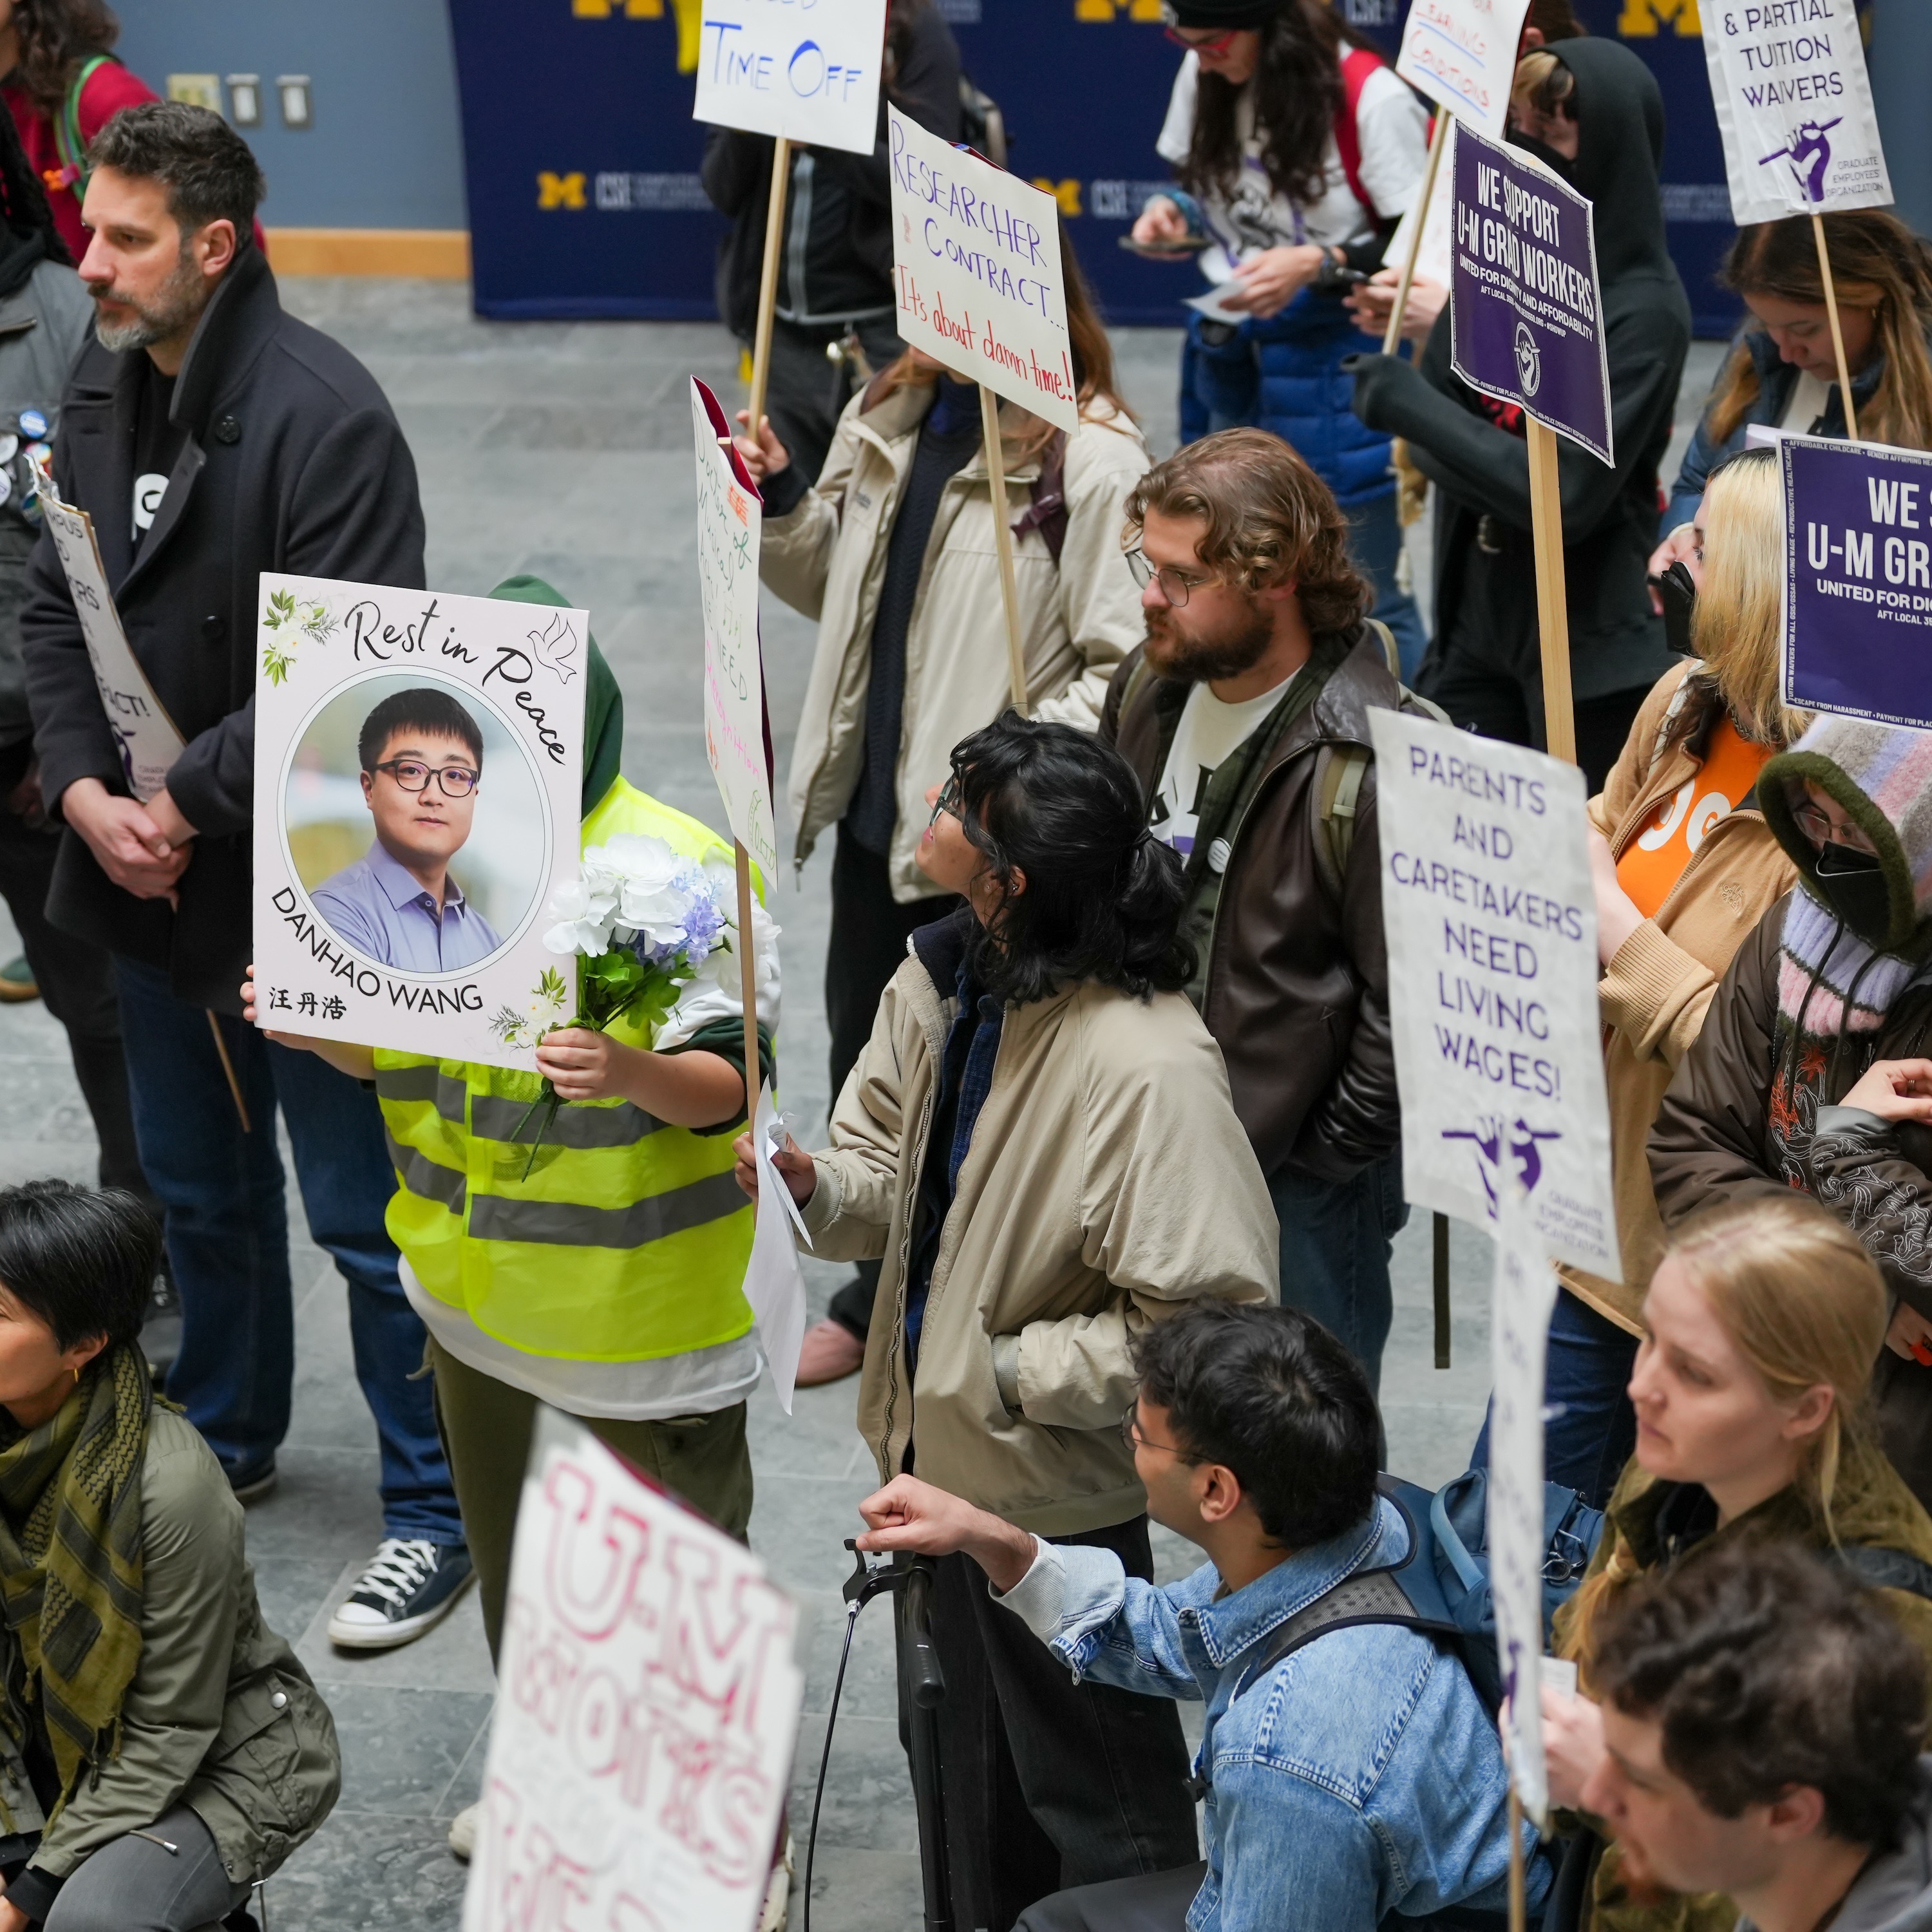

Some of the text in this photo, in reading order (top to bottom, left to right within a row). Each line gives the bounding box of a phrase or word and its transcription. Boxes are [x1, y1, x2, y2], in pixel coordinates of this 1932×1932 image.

[1724, 0, 1834, 35] & PARTIAL
[705, 20, 862, 102] TIME OFF
[1408, 30, 1490, 107] CONDITIONS
[1740, 33, 1833, 71] TUITION
[1741, 71, 1844, 108] WAIVERS
[537, 171, 586, 211] M
[1825, 182, 1885, 198] ORGANIZATION
[1837, 156, 1879, 170] GRADUATE
[891, 119, 1048, 267] RESEARCHER
[1477, 161, 1501, 212] WE
[1503, 175, 1559, 248] SUPPORT
[1458, 200, 1479, 256] U-M
[1483, 218, 1520, 279] GRAD
[1522, 241, 1595, 322] WORKERS
[1459, 252, 1479, 278] UNITED
[1480, 267, 1500, 285] FOR
[1501, 274, 1522, 302] DIGNITY
[1522, 291, 1537, 310] AND
[1538, 300, 1593, 342] AFFORDABILITY
[1481, 285, 1492, 296] AFT
[1491, 289, 1506, 301] LOCAL
[1546, 321, 1567, 338] #SHOWUP
[896, 264, 1074, 402] It's about damn time!
[1481, 381, 1497, 392] PAYMENT
[1785, 447, 1794, 487] HEALTHCARE
[1789, 439, 1862, 455] AFFORDABLE CHILDCARE
[1867, 450, 1889, 460] GENDER
[1890, 454, 1922, 466] AFFIRMING
[693, 399, 752, 570] Doctor of
[1868, 477, 1920, 529] WE
[699, 481, 734, 598] Musical
[1808, 522, 1932, 589] U-M GR
[1817, 578, 1875, 603] UNITED
[1876, 590, 1911, 609] FOR
[1877, 609, 1893, 621] AFT
[1895, 612, 1922, 625] LOCAL
[344, 599, 566, 766] Rest in Peace
[716, 628, 748, 701] NEED
[1794, 697, 1873, 718] ESCAPE FROM HARASSMENT
[1876, 712, 1904, 724] PAYMENT
[1905, 717, 1917, 726] FOR
[1408, 743, 1547, 816] PARENTS
[1452, 813, 1513, 860] AND
[1390, 851, 1583, 941] CARETAKERS
[271, 886, 484, 1015] DANHAO WANG
[1443, 917, 1539, 980] NEED
[269, 986, 348, 1021] 汪丹浩
[1438, 970, 1550, 1041] LIVING
[1434, 1022, 1562, 1103] WAGES!
